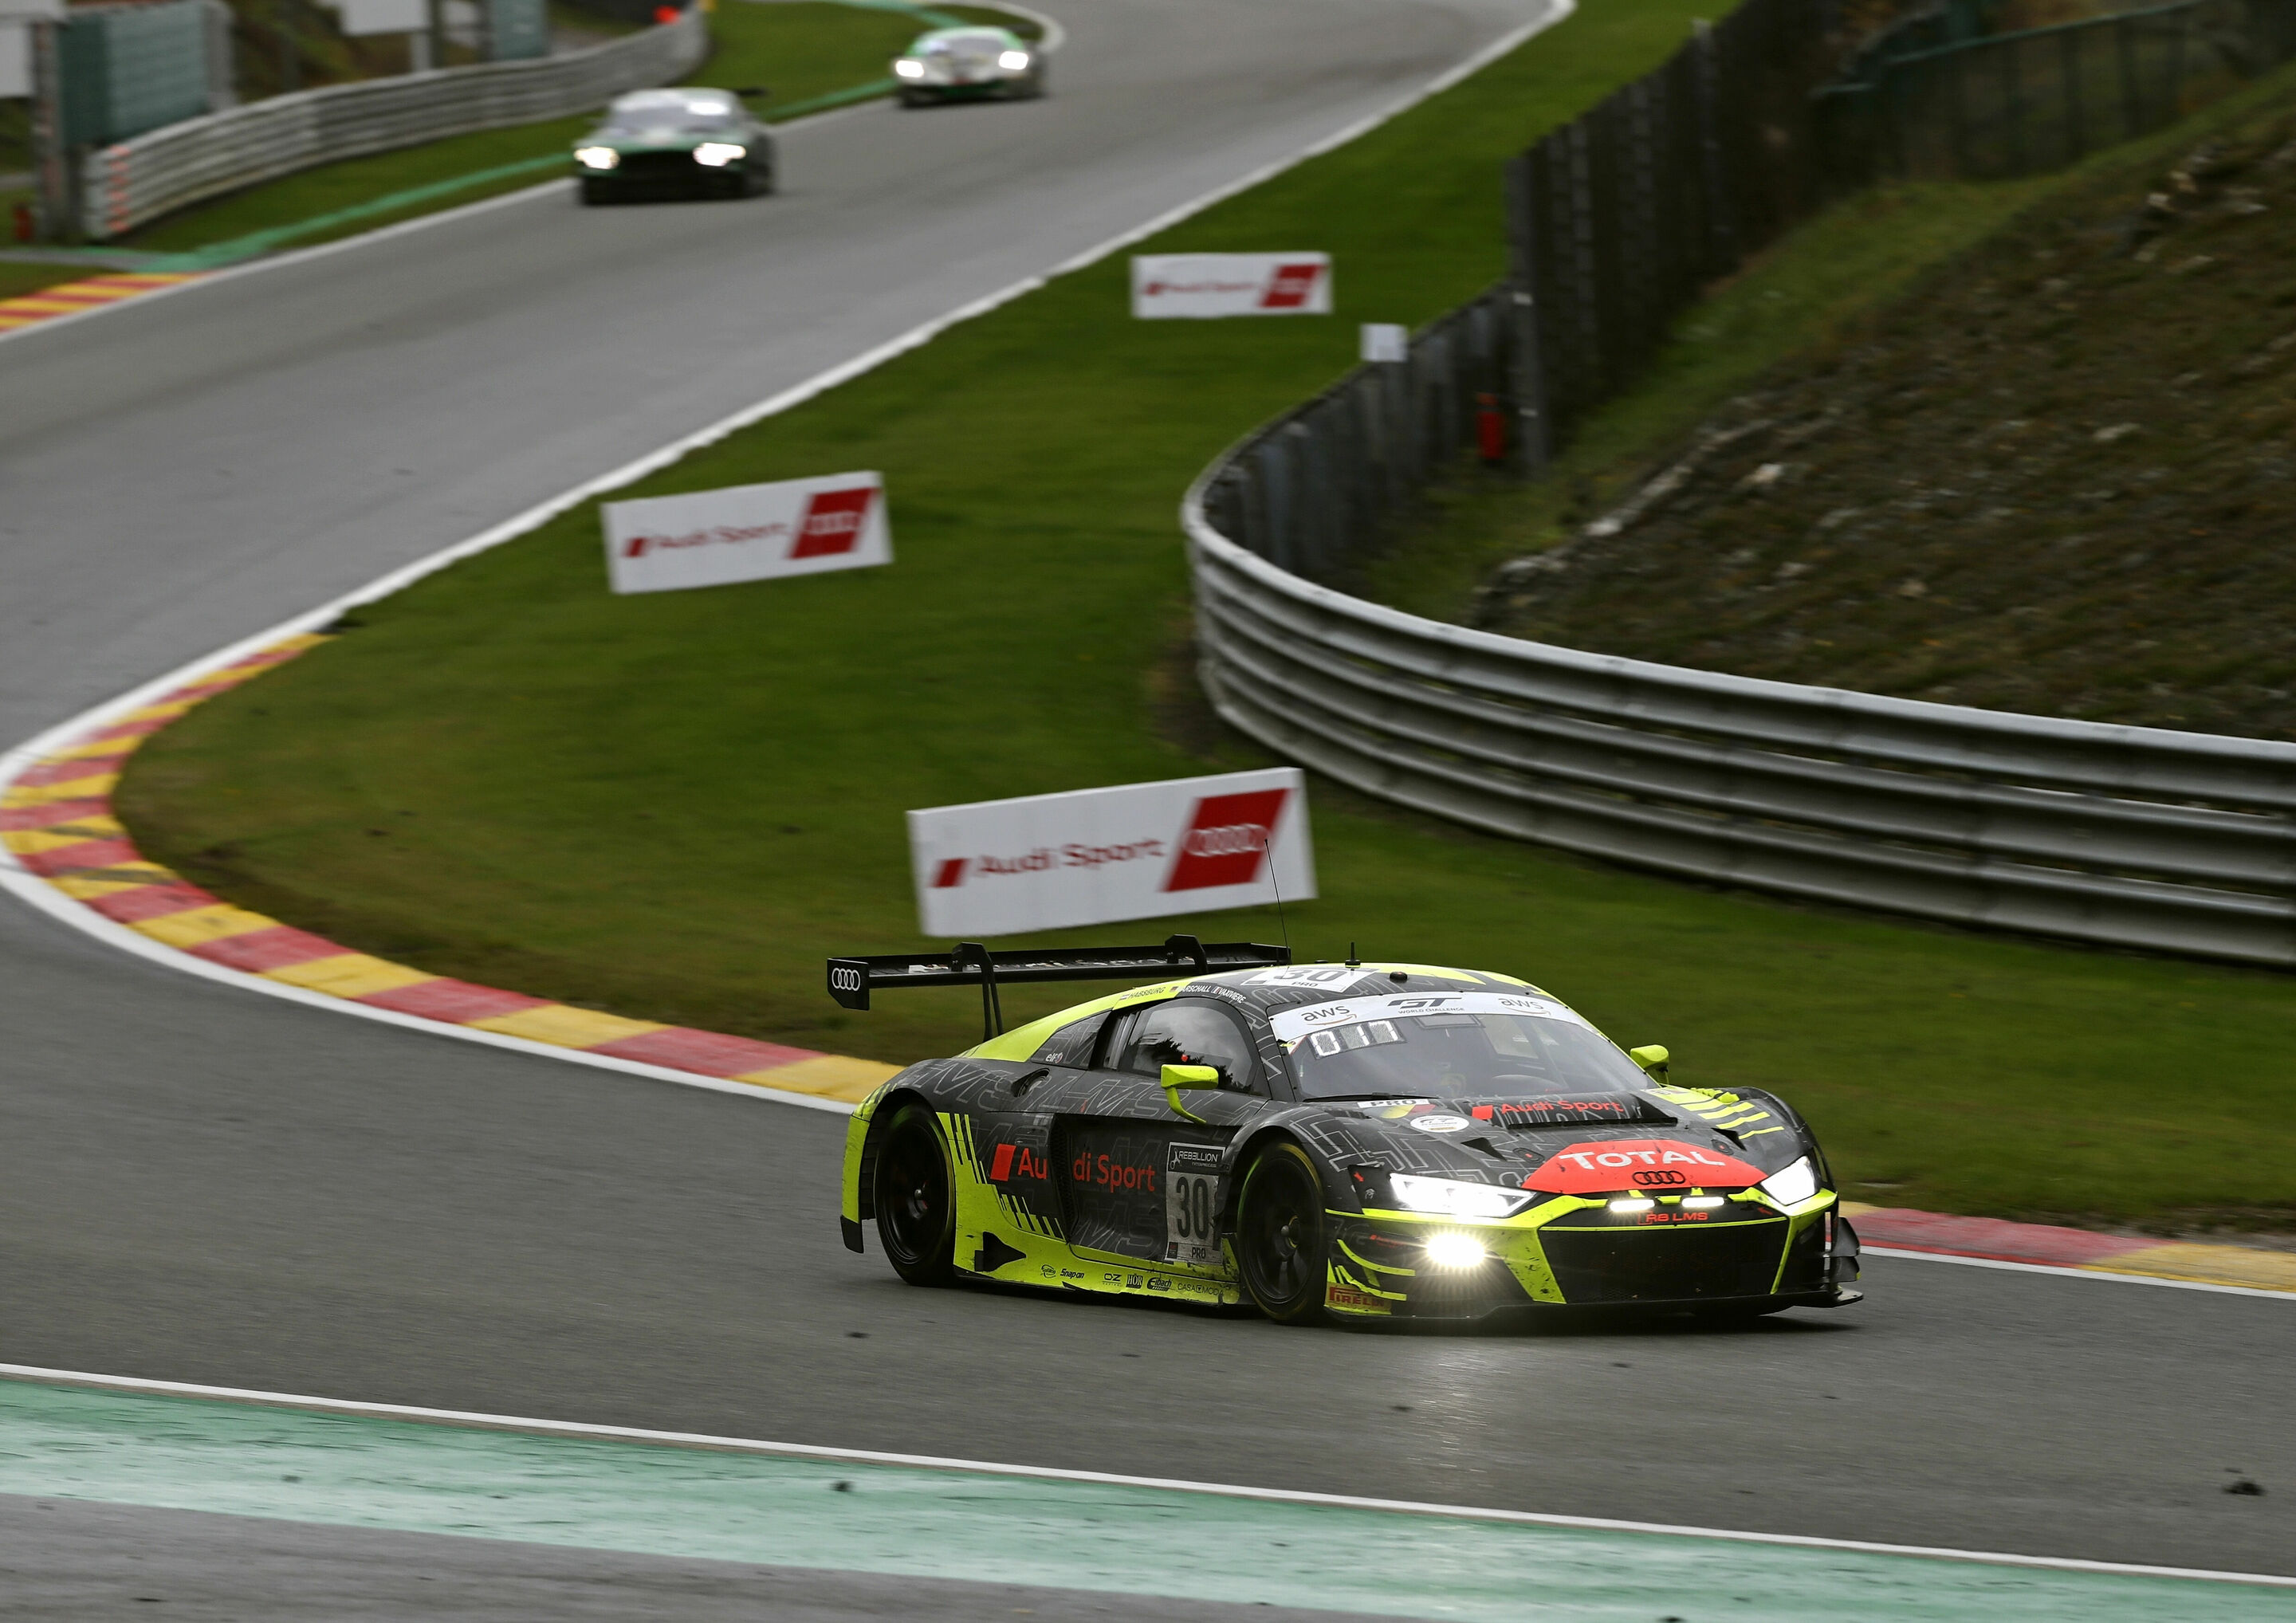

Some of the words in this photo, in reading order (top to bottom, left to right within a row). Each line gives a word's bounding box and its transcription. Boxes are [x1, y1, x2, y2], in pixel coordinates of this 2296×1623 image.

[976, 848, 1059, 878] Audi
[1060, 837, 1167, 870] Sport
[1274, 969, 1348, 982] 30
[1128, 986, 1166, 999] HABSBURG
[1218, 986, 1247, 1004] VAXIVIERE
[1498, 998, 1544, 1010] aws
[1301, 1005, 1350, 1022] aws
[1045, 1052, 1058, 1063] elf
[1501, 1101, 1555, 1114] Audi
[1557, 1100, 1624, 1113] Sport
[1178, 1150, 1218, 1162] REBELLION
[1559, 1150, 1726, 1170] TOTAL
[1096, 1154, 1155, 1193] Sport
[1176, 1176, 1209, 1240] 30
[1645, 1213, 1669, 1222] R8
[1672, 1212, 1708, 1221] LMS
[1192, 1247, 1206, 1259] PRO
[1060, 1267, 1085, 1279] Snap-on
[1103, 1272, 1123, 1282] OZ
[1148, 1276, 1173, 1288] Eibach
